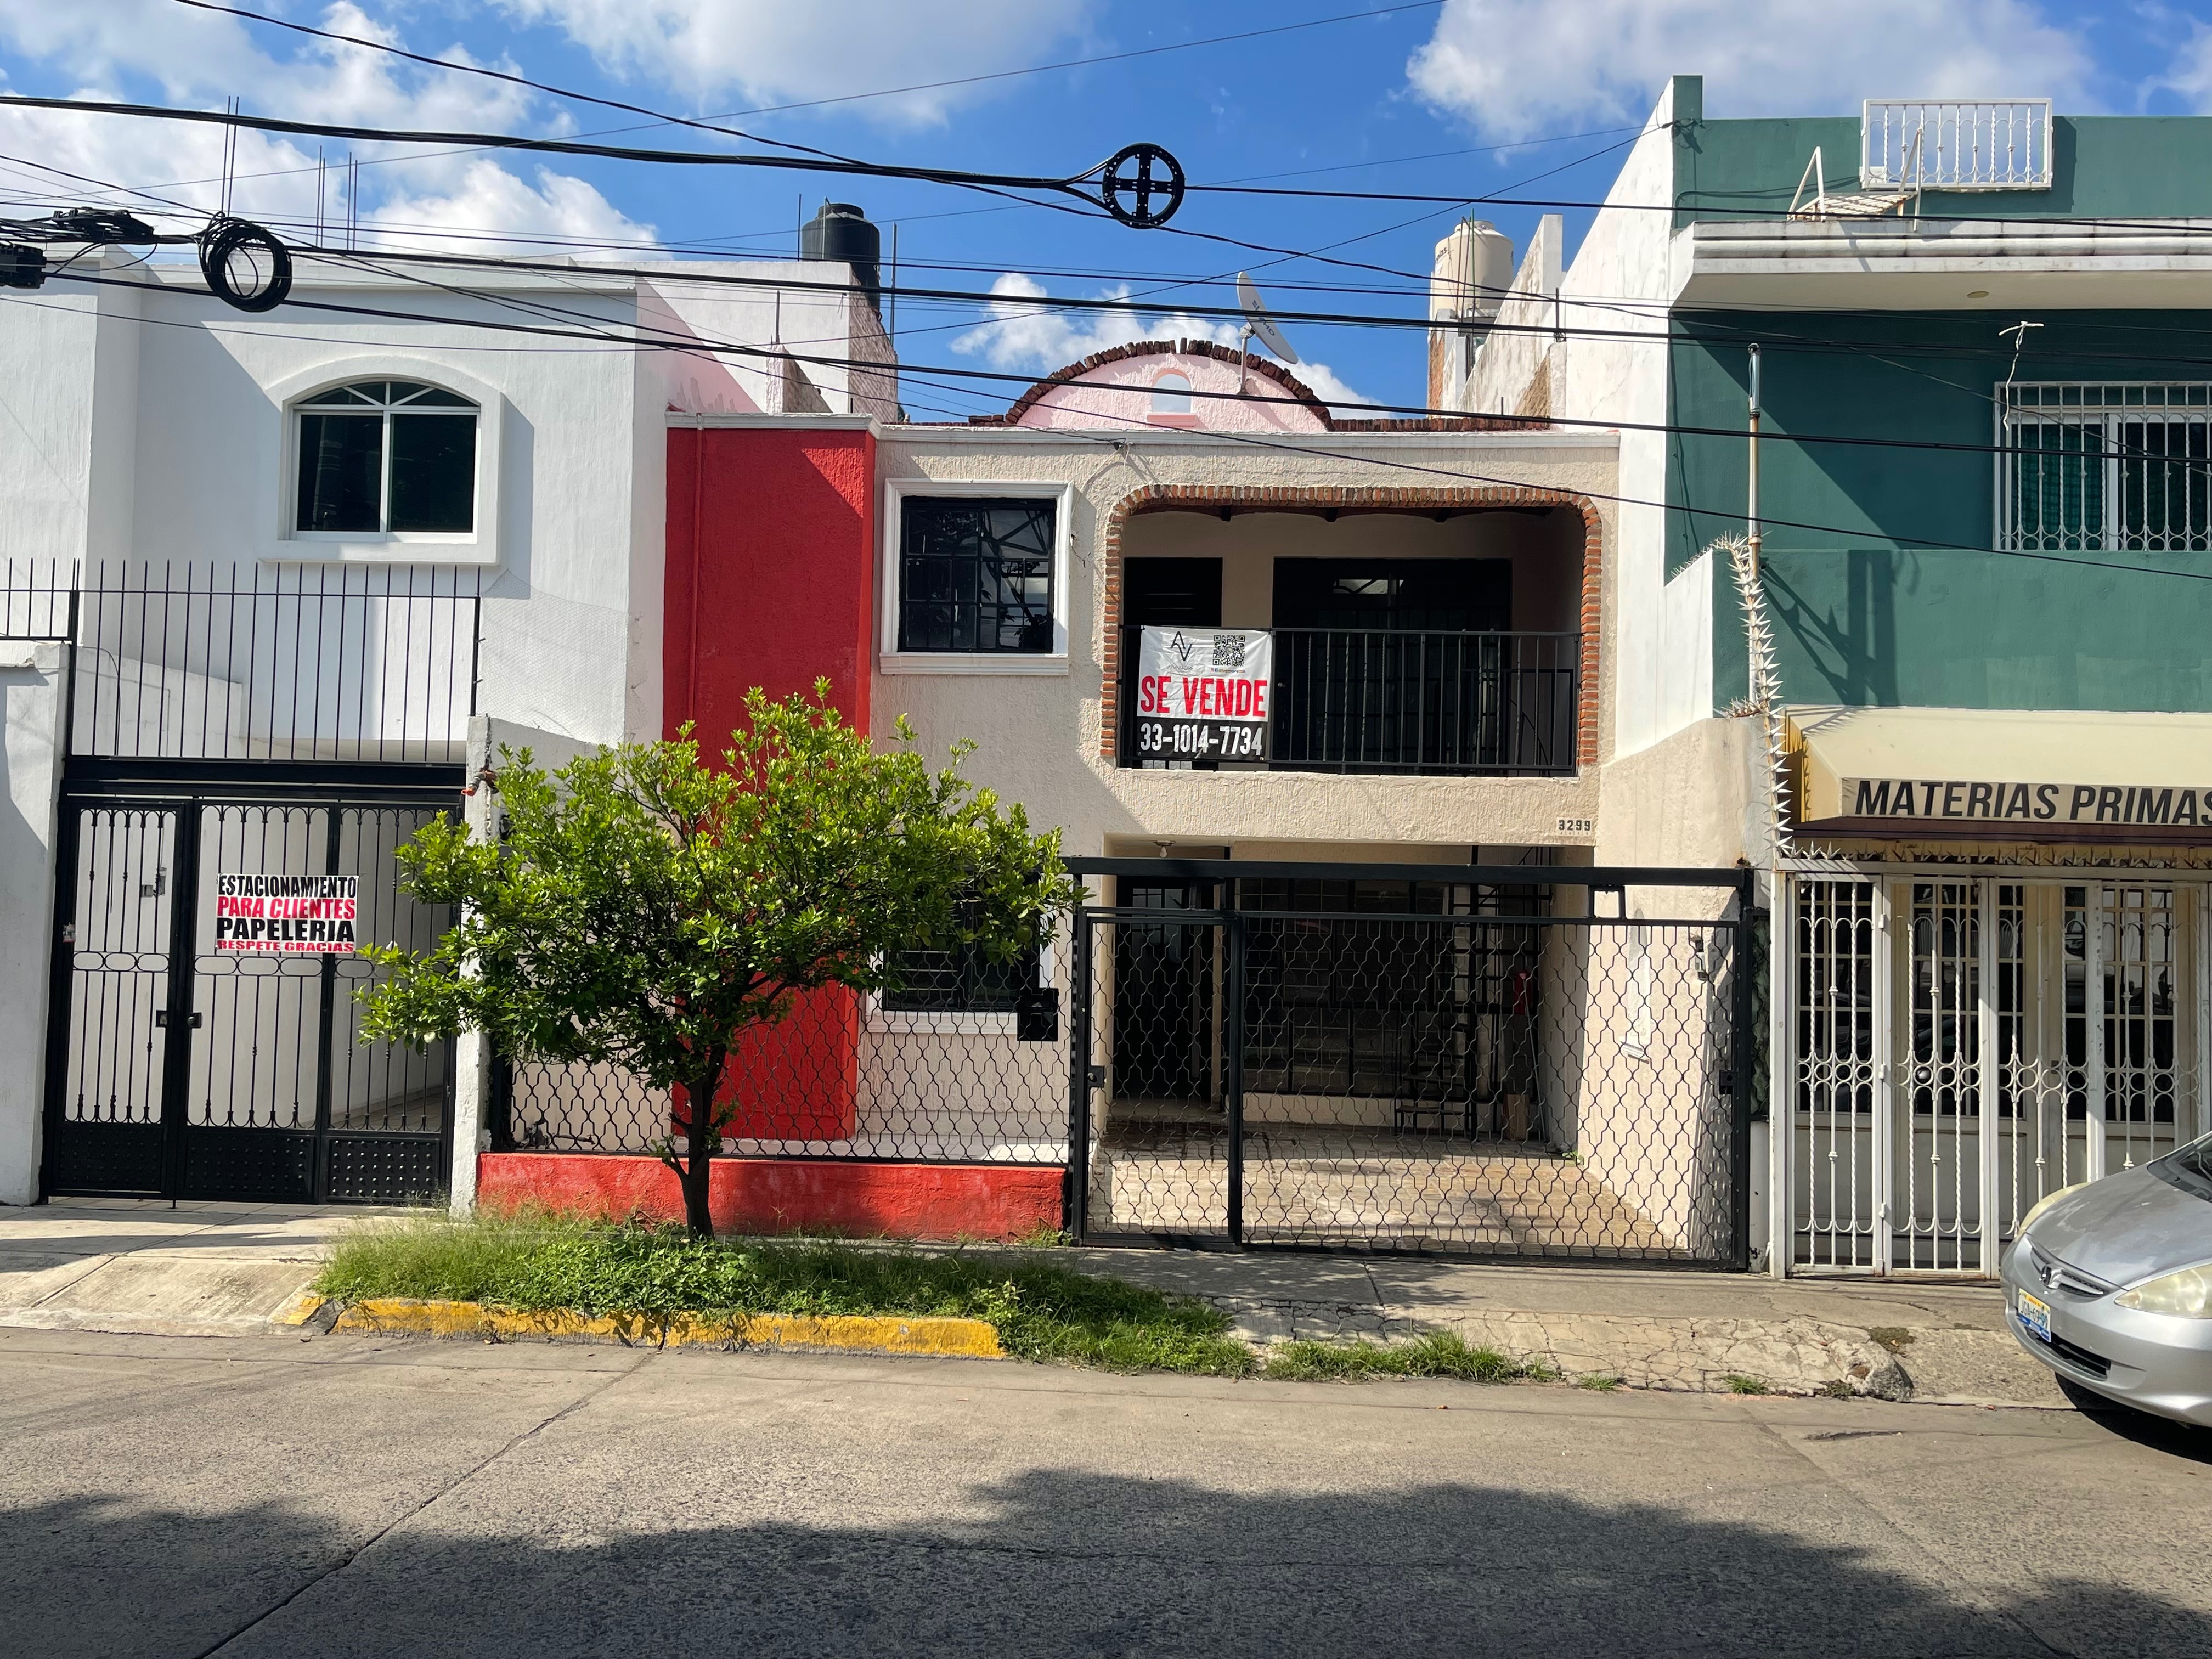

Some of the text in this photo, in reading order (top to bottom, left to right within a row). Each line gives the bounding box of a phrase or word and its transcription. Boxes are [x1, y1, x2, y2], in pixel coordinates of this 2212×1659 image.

[1141, 676, 1268, 718] SE VENDE
[1140, 723, 1263, 756] 33-1014-7734
[1855, 781, 2059, 819] MATERIAS
[1559, 820, 1590, 831] 3299
[218, 875, 356, 898] ESTACIONAMIENTO
[217, 896, 356, 919] PARA CLIENTES
[217, 917, 355, 942] PAPELERIA
[217, 940, 354, 952] RESPETE GRACIAS
